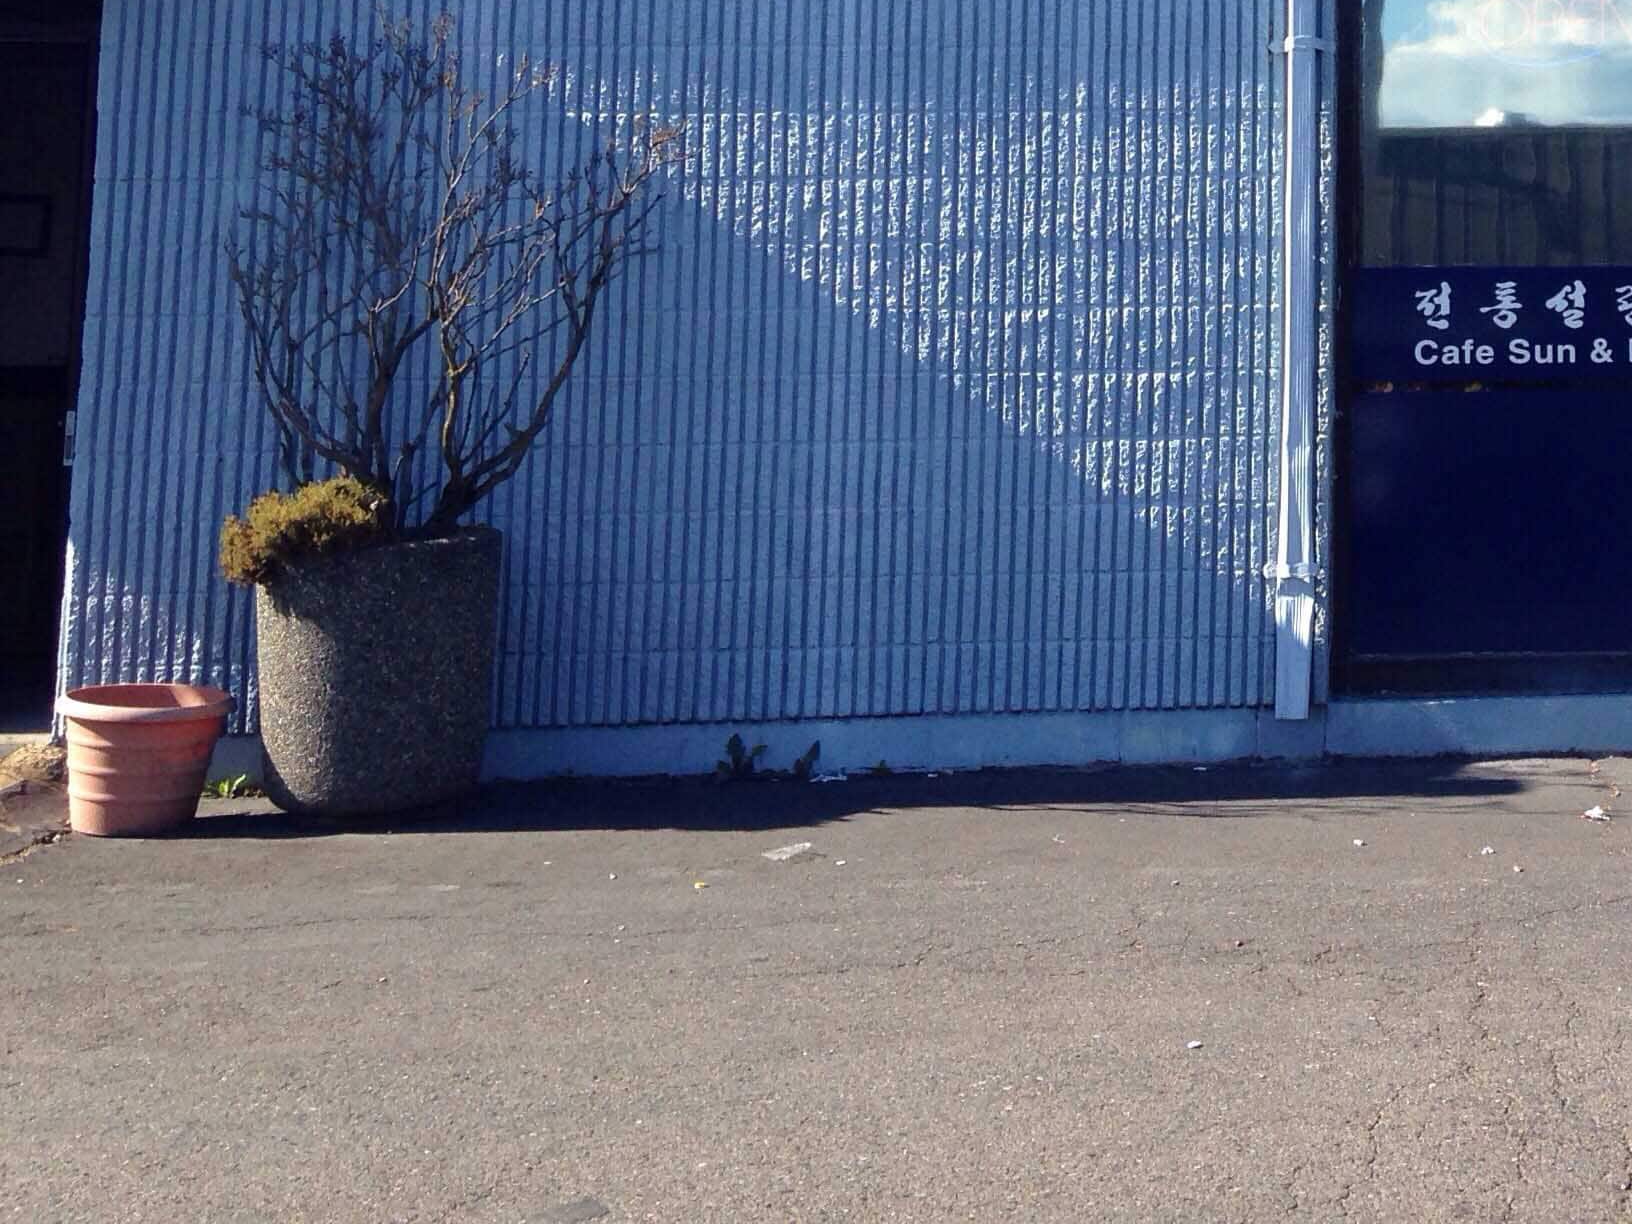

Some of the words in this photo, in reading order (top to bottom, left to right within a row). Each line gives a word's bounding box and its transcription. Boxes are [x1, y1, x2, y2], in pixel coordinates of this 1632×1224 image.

[1414, 339, 1495, 365] Cafe
[1508, 339, 1576, 364] Sun
[1590, 338, 1614, 363] &
